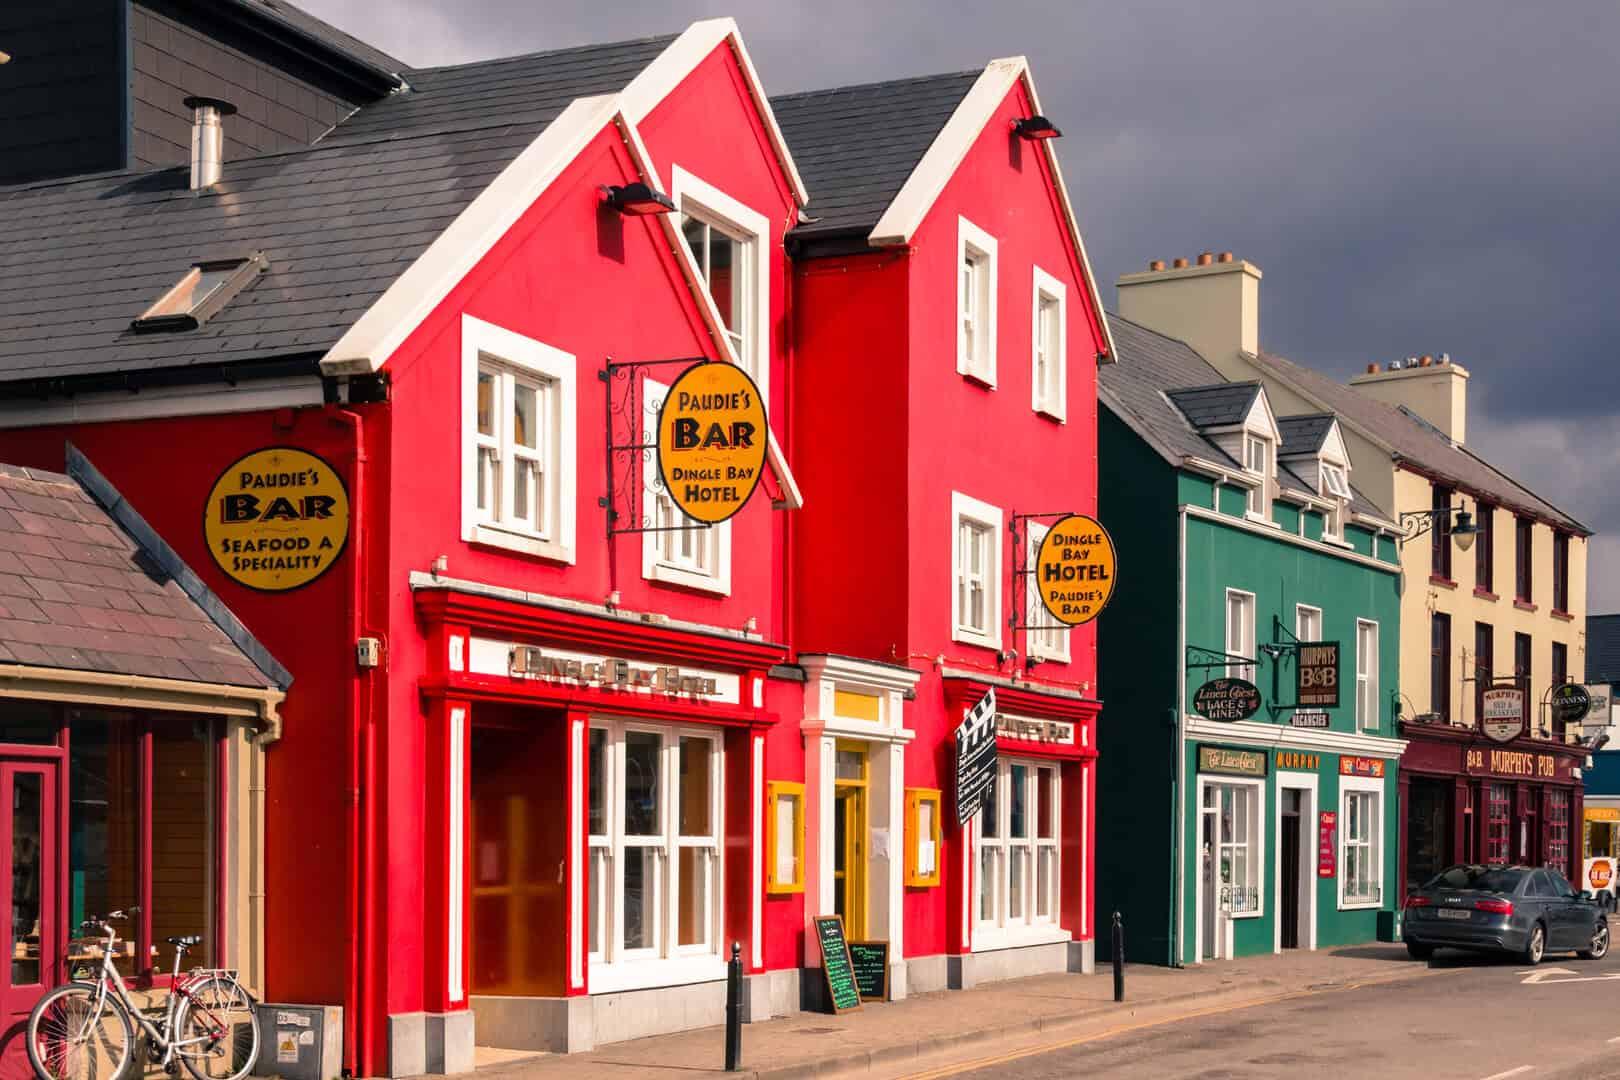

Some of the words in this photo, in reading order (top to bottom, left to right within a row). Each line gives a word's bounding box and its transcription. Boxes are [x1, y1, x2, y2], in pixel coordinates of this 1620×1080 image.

[679, 389, 751, 412] PAUDIE'S
[672, 418, 756, 451] BAR
[240, 468, 319, 489] PAUDIE'S
[673, 467, 721, 481] DINGLE
[727, 466, 754, 480] BAY
[685, 485, 740, 502] HOTEL
[220, 494, 337, 524] BAR
[222, 537, 310, 553] SEAFOOD
[319, 536, 333, 549] A
[1053, 534, 1102, 546] DINGLE
[1062, 548, 1090, 560] BAY
[233, 555, 321, 571] SPECIALITY
[1044, 563, 1109, 582] HOTEL
[1051, 589, 1103, 602] PAUDIE'S
[1062, 604, 1090, 615] BAR
[1300, 667, 1336, 687] B&B
[1276, 751, 1319, 768] MURPHY
[1538, 755, 1554, 776] PUB
